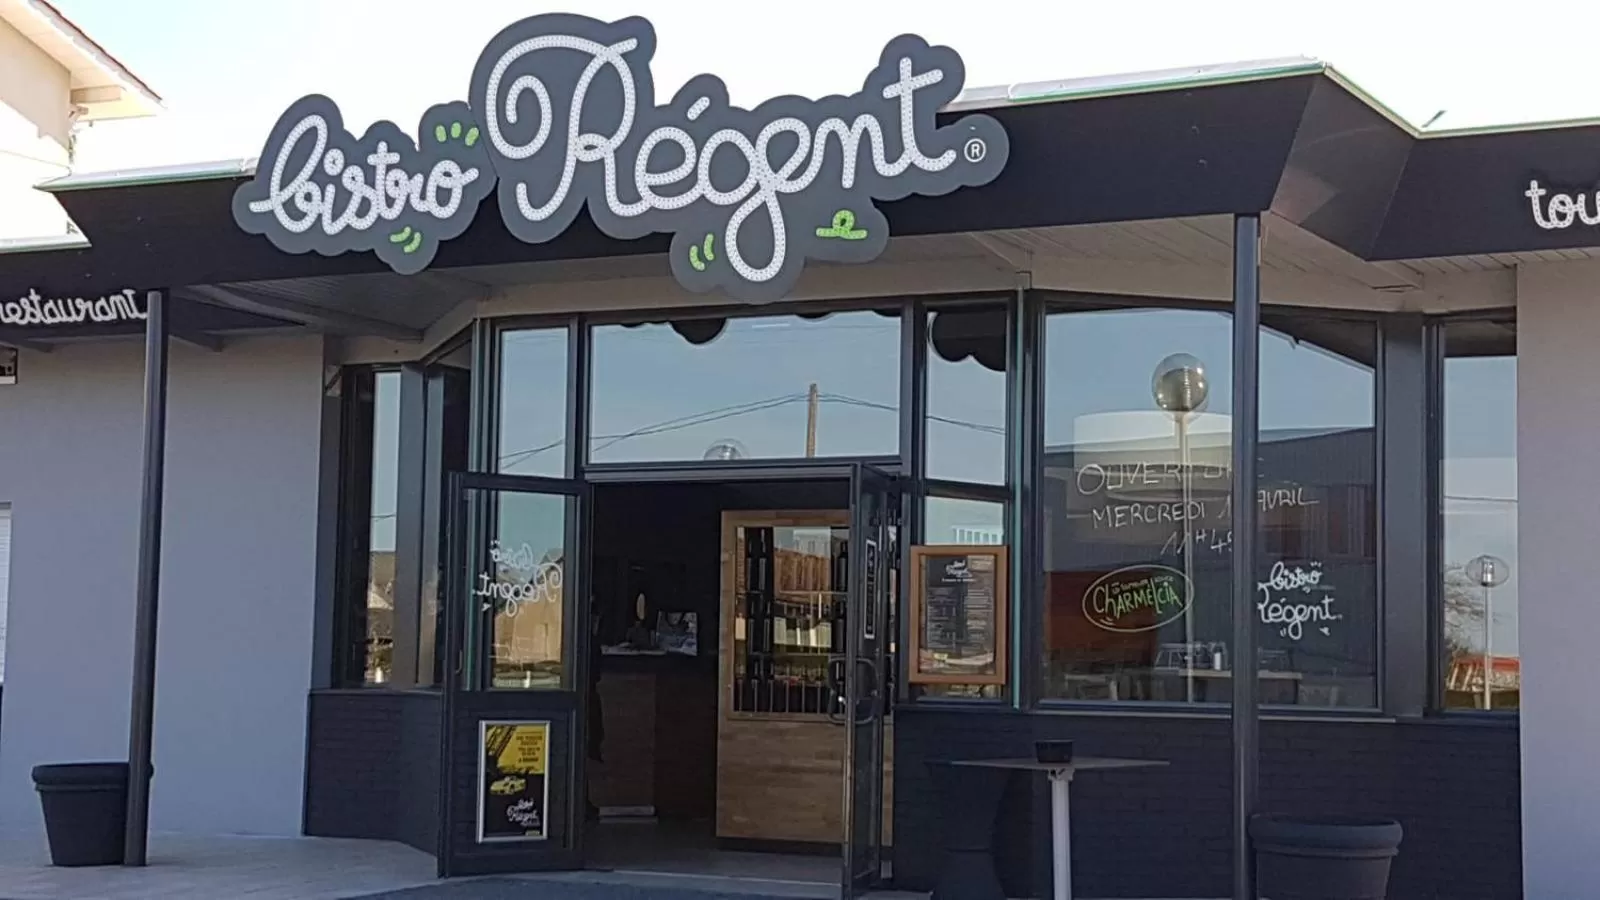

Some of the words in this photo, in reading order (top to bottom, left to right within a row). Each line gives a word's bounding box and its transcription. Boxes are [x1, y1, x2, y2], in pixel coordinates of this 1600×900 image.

[250, 114, 480, 235] bistro
[485, 35, 957, 282] Régent
[1092, 501, 1206, 529] MERCREDI
